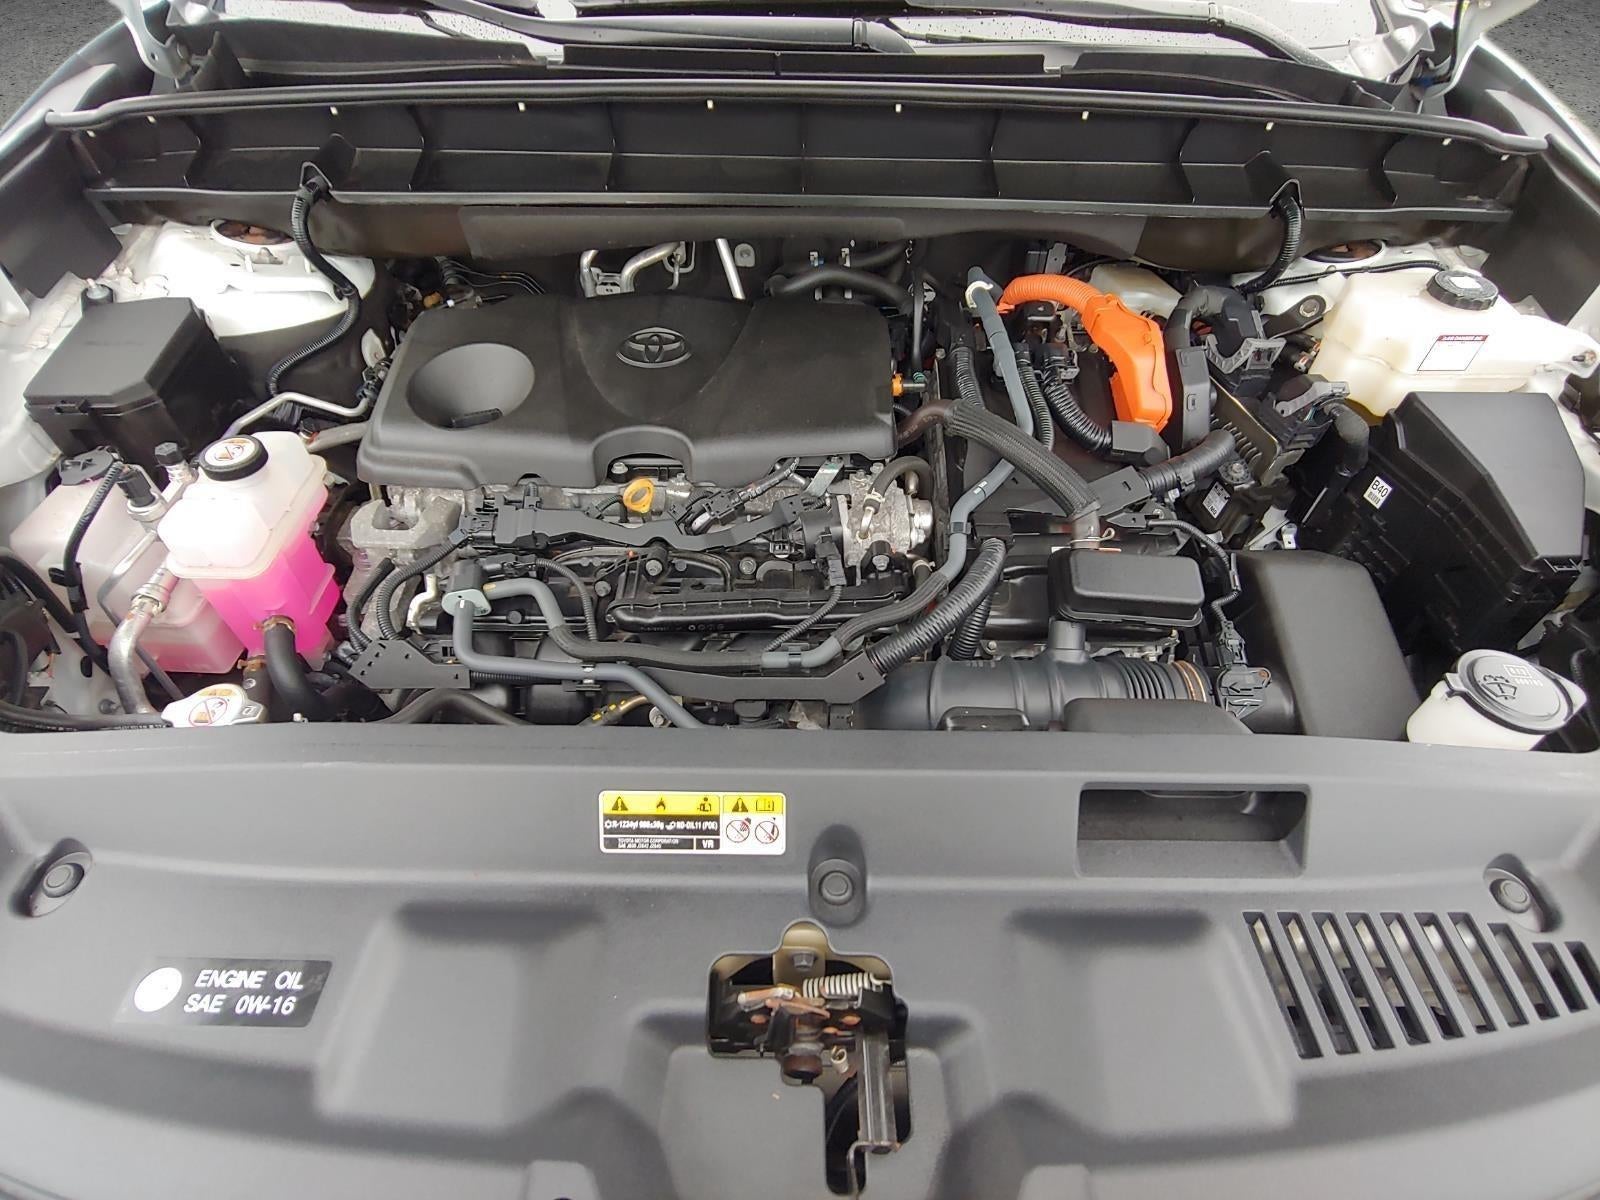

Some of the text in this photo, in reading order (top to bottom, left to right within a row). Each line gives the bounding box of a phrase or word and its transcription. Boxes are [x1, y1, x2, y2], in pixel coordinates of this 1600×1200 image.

[1371, 479, 1389, 498] B40
[702, 839, 715, 849] VR
[194, 969, 305, 991] ENGINE OIL
[183, 993, 298, 1016] SAE 0W-16
